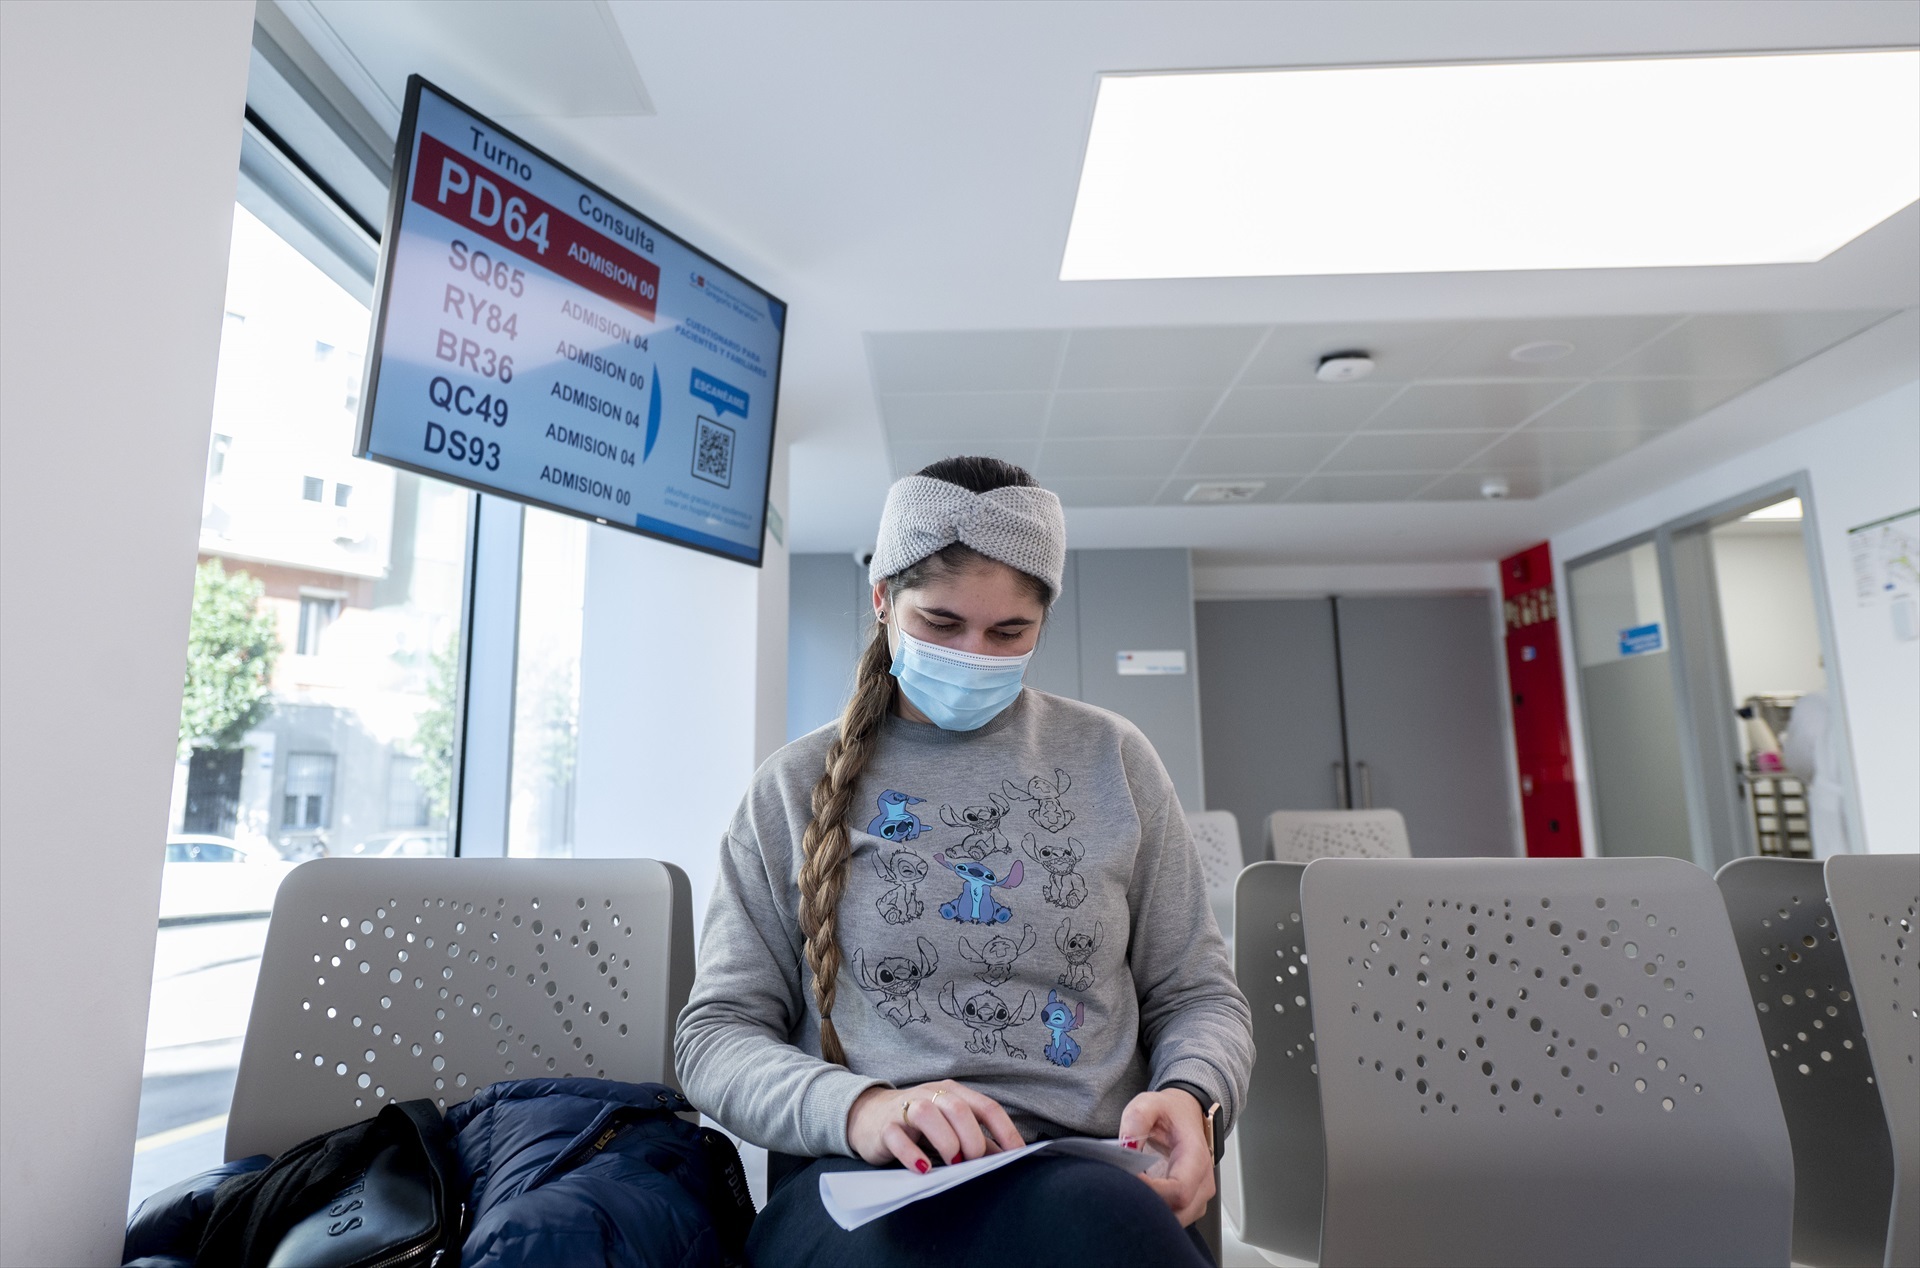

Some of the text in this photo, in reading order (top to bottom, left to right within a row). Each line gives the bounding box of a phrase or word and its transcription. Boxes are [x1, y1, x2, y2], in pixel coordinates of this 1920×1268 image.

[470, 126, 532, 182] Turno
[437, 156, 550, 255] PD64
[578, 194, 655, 254] Consulta
[448, 239, 525, 299] SQ65
[567, 242, 655, 300] ADMISION 00
[443, 283, 519, 342] RY84
[561, 299, 649, 353] ADMISION 04
[675, 324, 718, 354] PACIENTES
[436, 328, 514, 385] BR36
[556, 340, 644, 390] ADMISION 00
[429, 376, 509, 428] QC49
[551, 381, 640, 429] ADMISION 04
[423, 421, 501, 472] DS93
[545, 422, 635, 468] ADMISION 04
[539, 464, 631, 506] ADMISION 00
